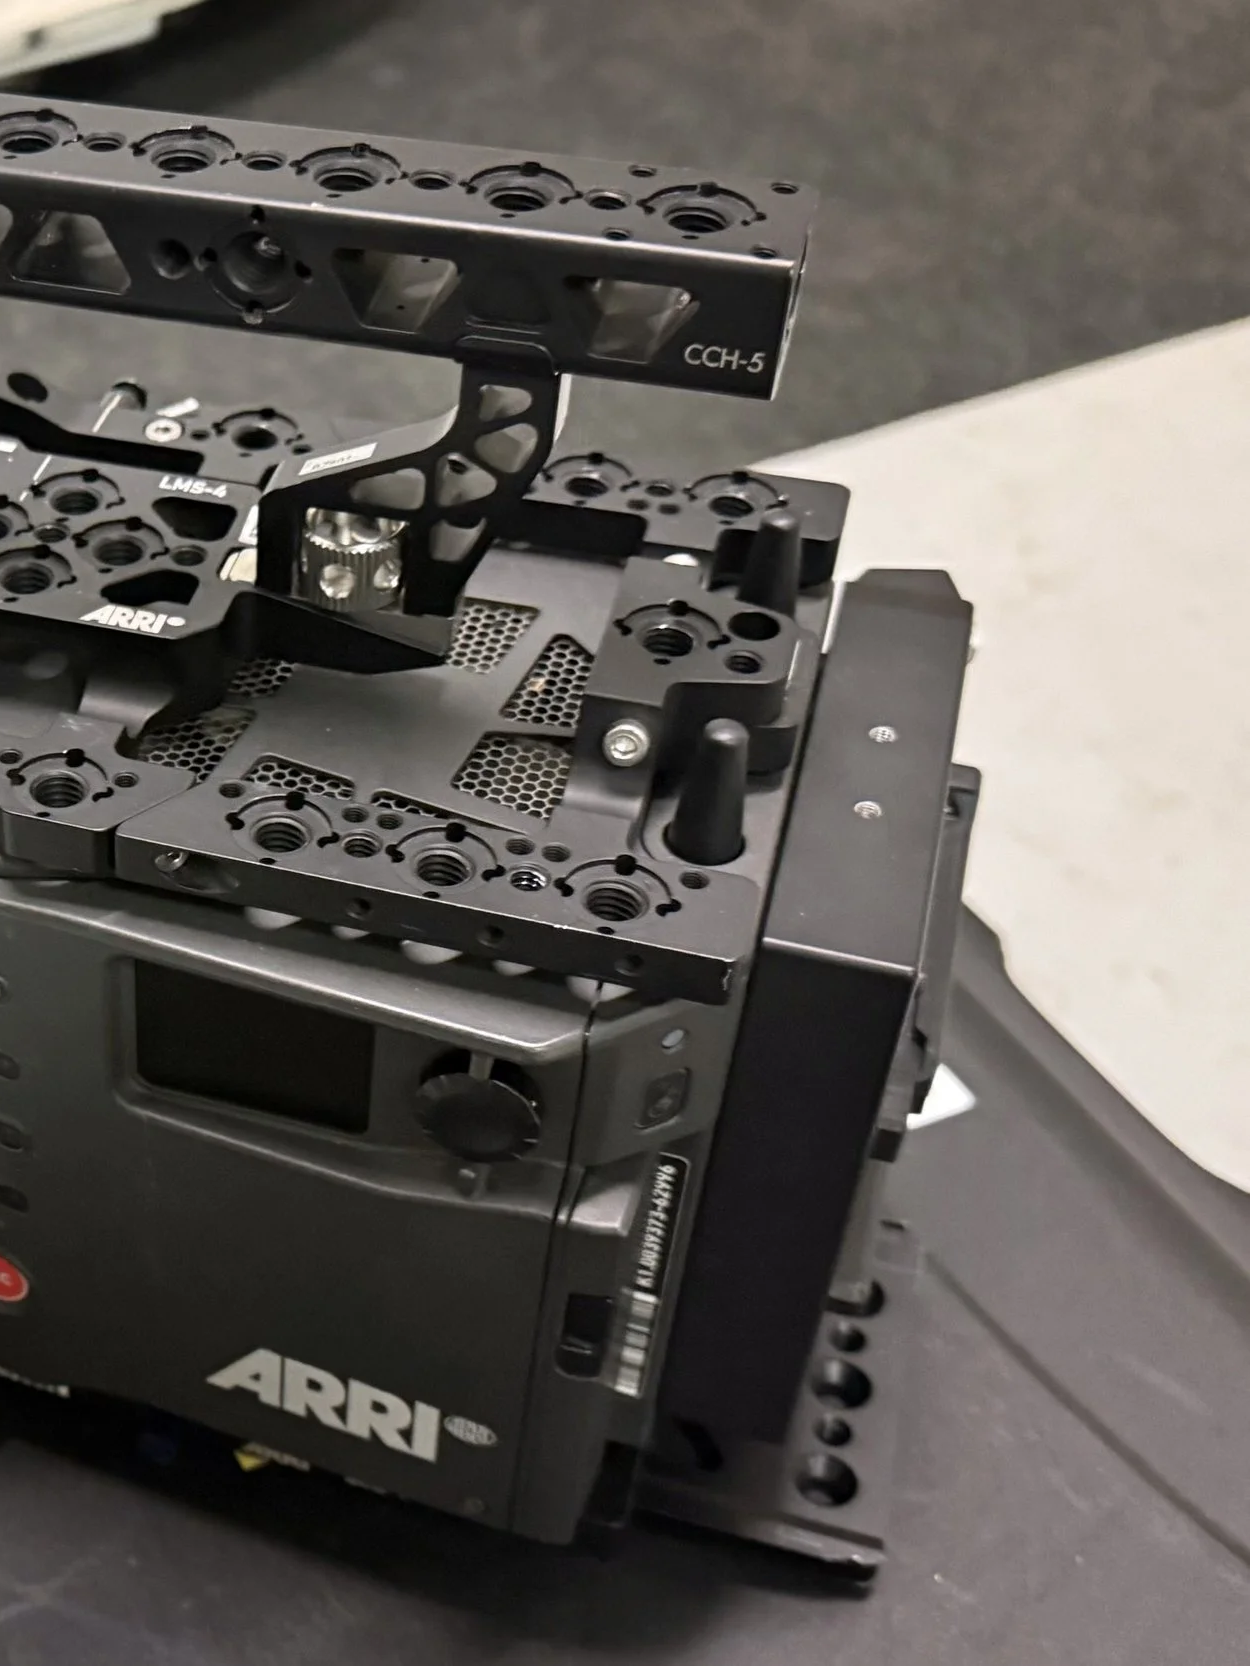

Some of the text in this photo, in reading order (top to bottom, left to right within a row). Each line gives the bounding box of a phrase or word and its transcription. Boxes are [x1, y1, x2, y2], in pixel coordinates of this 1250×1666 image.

[684, 343, 766, 373] CCH-5
[158, 475, 227, 498] LMS-4
[78, 604, 168, 634] ARRI
[206, 1347, 440, 1464] ARRI
